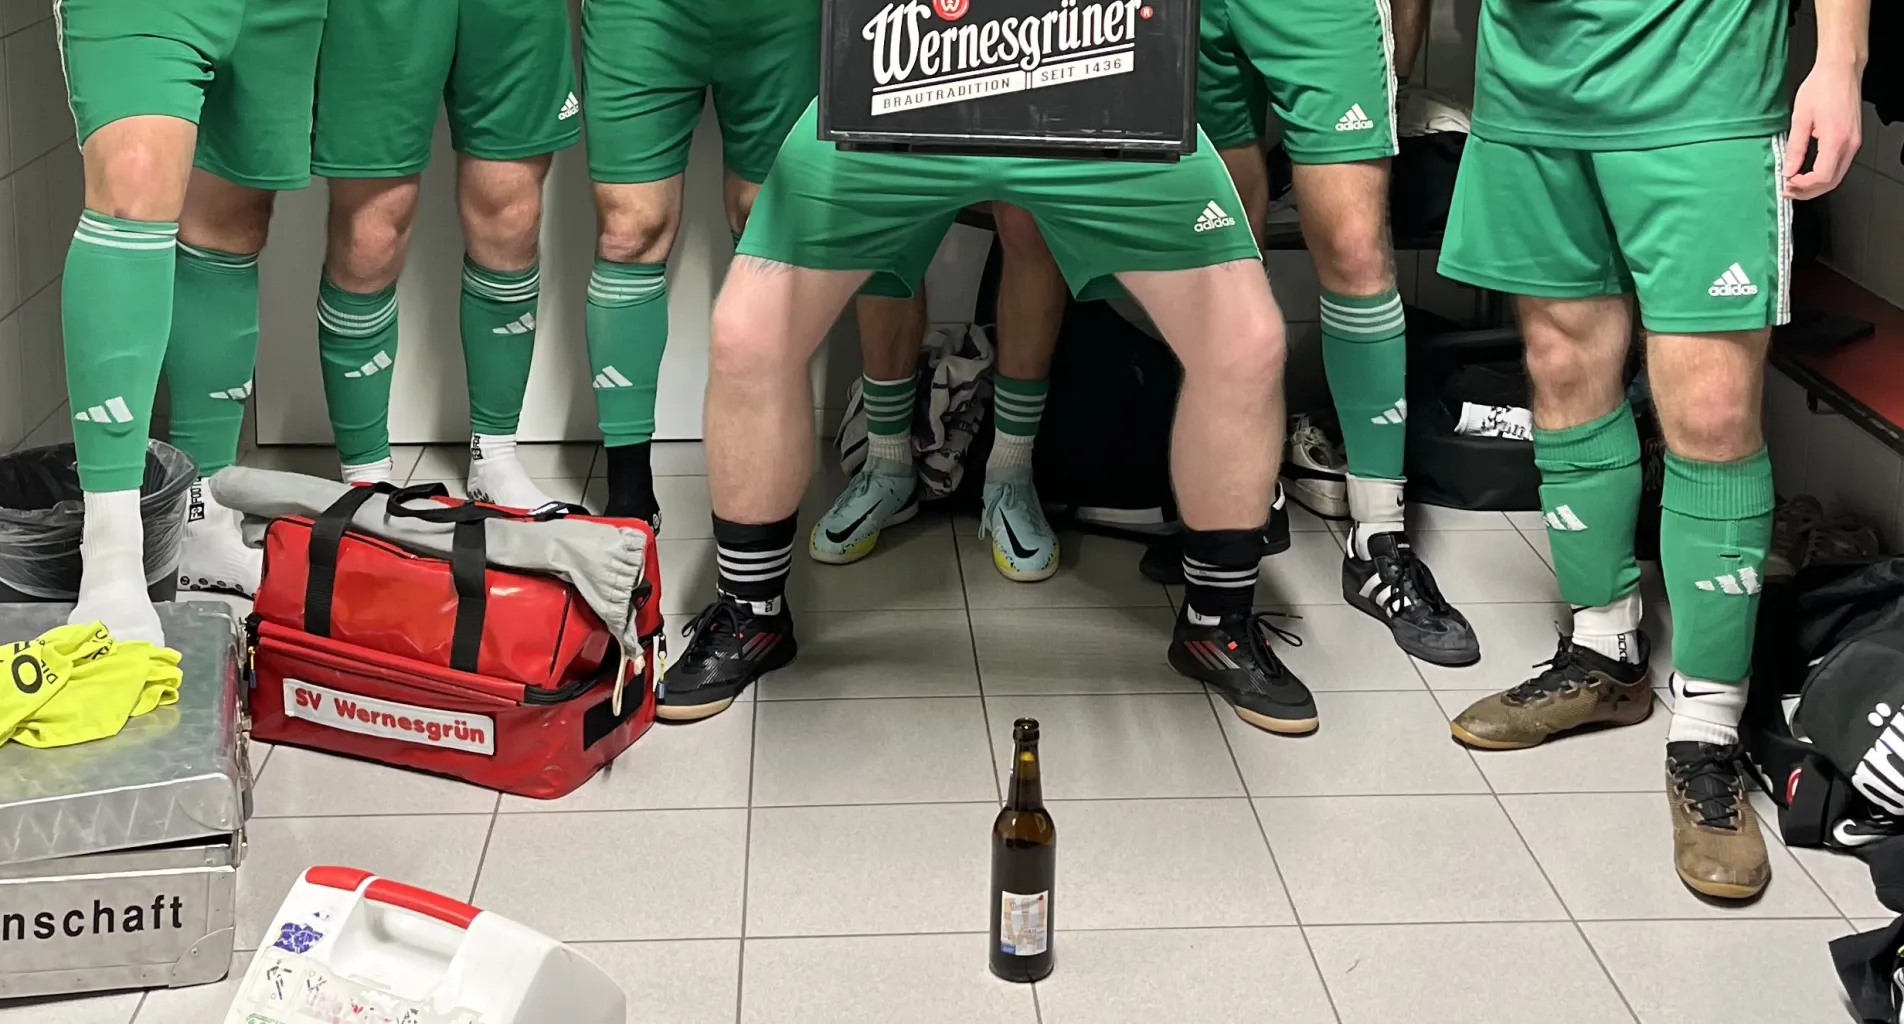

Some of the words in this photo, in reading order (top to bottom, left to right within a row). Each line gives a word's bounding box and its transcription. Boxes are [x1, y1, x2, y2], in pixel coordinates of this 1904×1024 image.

[883, 77, 1010, 110] BRAUTRADITION
[1041, 67, 1076, 82] SEIT
[1084, 58, 1122, 75] 1436
[1335, 120, 1374, 131] adidas
[1194, 217, 1236, 232] adidas
[1708, 284, 1759, 296] adidas
[294, 687, 322, 710] SV
[334, 697, 485, 744] Wernesgrün
[2, 894, 183, 941] nschaft
